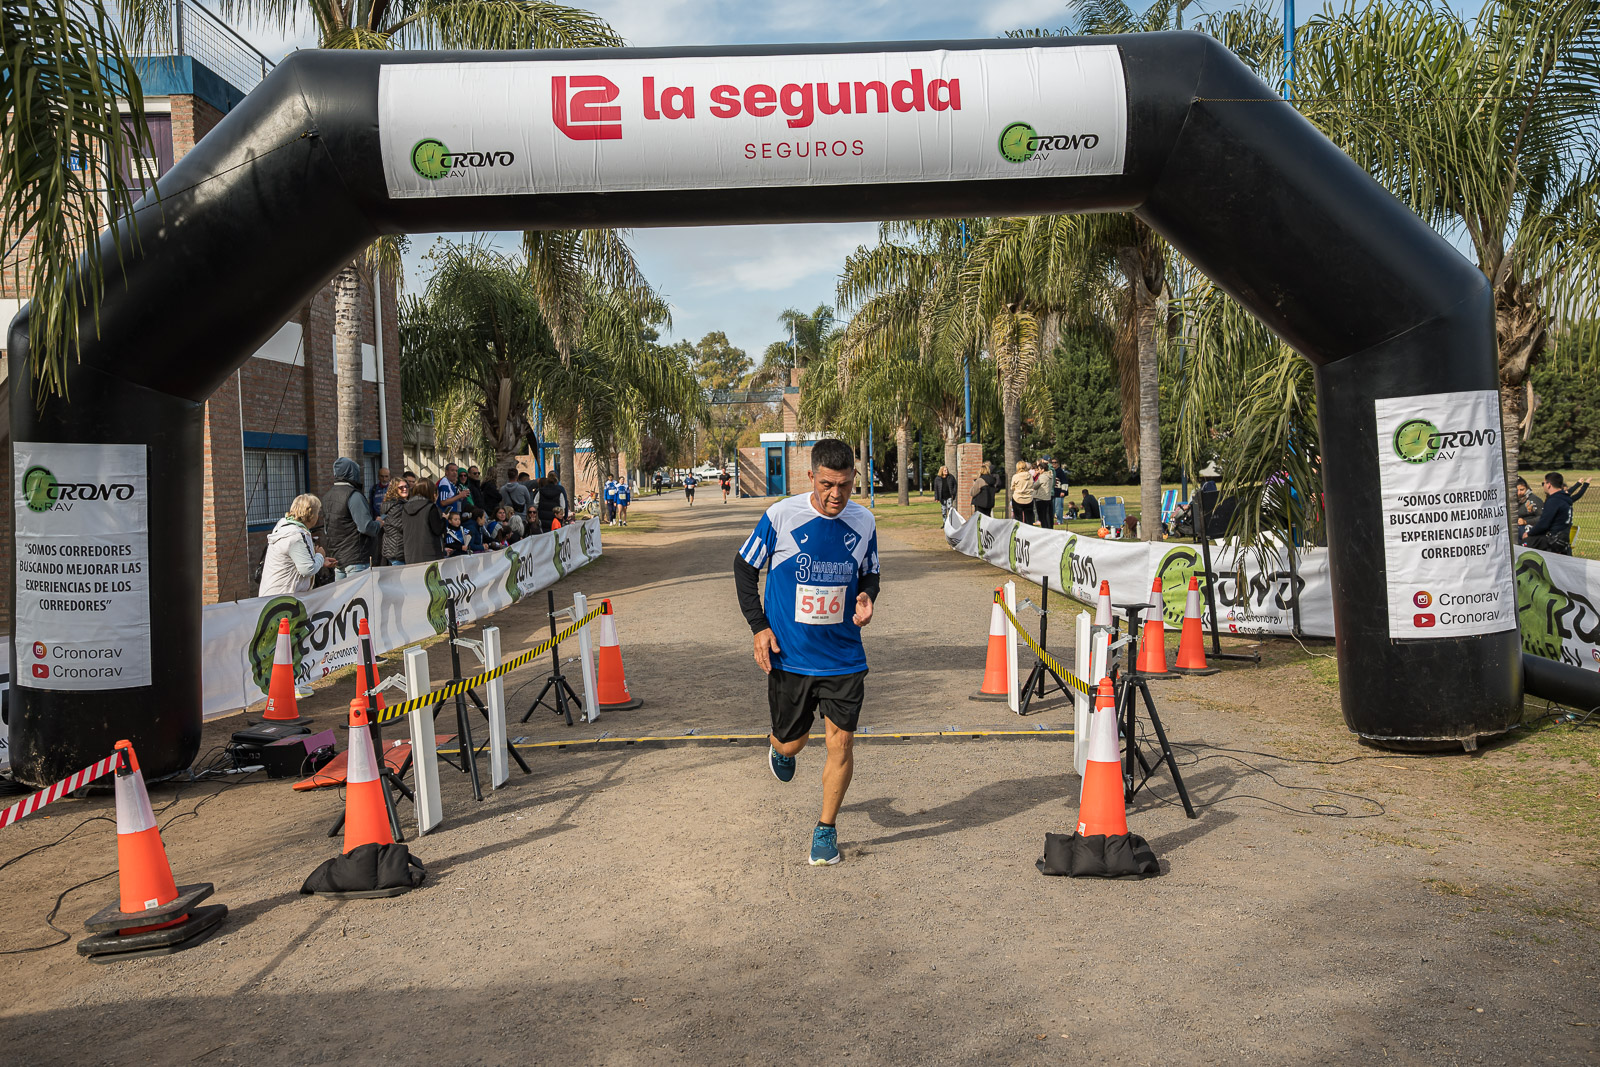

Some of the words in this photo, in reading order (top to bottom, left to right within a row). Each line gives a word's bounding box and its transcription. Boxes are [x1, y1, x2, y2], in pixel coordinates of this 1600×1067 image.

[642, 76, 696, 120] la
[709, 68, 962, 129] segunda
[744, 140, 865, 159] SEGUROS
[1025, 133, 1099, 152] CRONO
[439, 151, 515, 169] CRONO
[1024, 153, 1050, 162] RAV
[440, 169, 467, 179] RAV
[1426, 428, 1496, 450] CRONO
[1426, 451, 1456, 462] RAV
[46, 482, 135, 501] CRONO
[1443, 489, 1498, 505] CORREDORES
[45, 502, 74, 512] RAV
[1389, 511, 1449, 526] BUSCANDO
[1450, 508, 1493, 522] MEJORAR
[1493, 505, 1504, 518] LAS
[1401, 527, 1475, 543] EXPERIENCIAS
[1476, 526, 1487, 538] DE
[1488, 524, 1500, 536] LOS
[59, 544, 132, 557] CORREDORES
[19, 560, 64, 575] BUSCANDO
[66, 562, 119, 575] MEJORAR
[121, 561, 142, 574] LAS
[795, 553, 812, 582] 3
[812, 560, 854, 575] MARATÓN
[25, 579, 92, 593] EXPERIENCIAS
[94, 581, 109, 593] DE
[111, 580, 132, 592] LOS
[801, 595, 841, 615] 516
[1439, 590, 1500, 606] Cronorav
[1439, 608, 1500, 625] Cronorav
[52, 645, 123, 660] Cronorav
[52, 665, 123, 679] Cronorav
